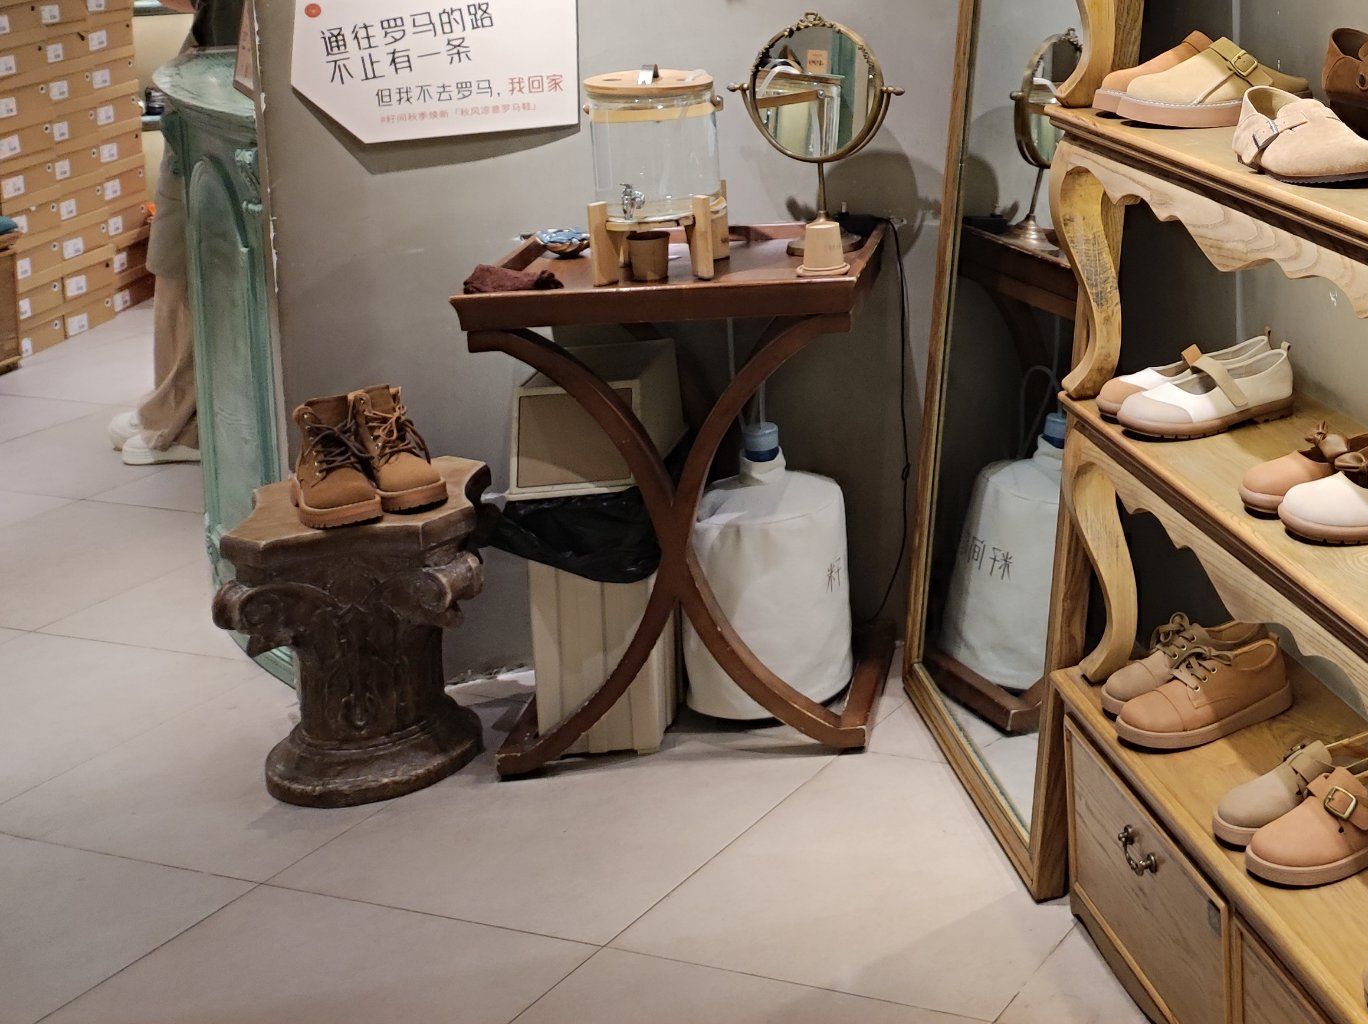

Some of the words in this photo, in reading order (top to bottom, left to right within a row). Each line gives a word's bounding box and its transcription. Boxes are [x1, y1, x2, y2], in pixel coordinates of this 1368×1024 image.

[320, 1, 494, 57] 通往罗马的路
[325, 36, 472, 86] 不止有一条
